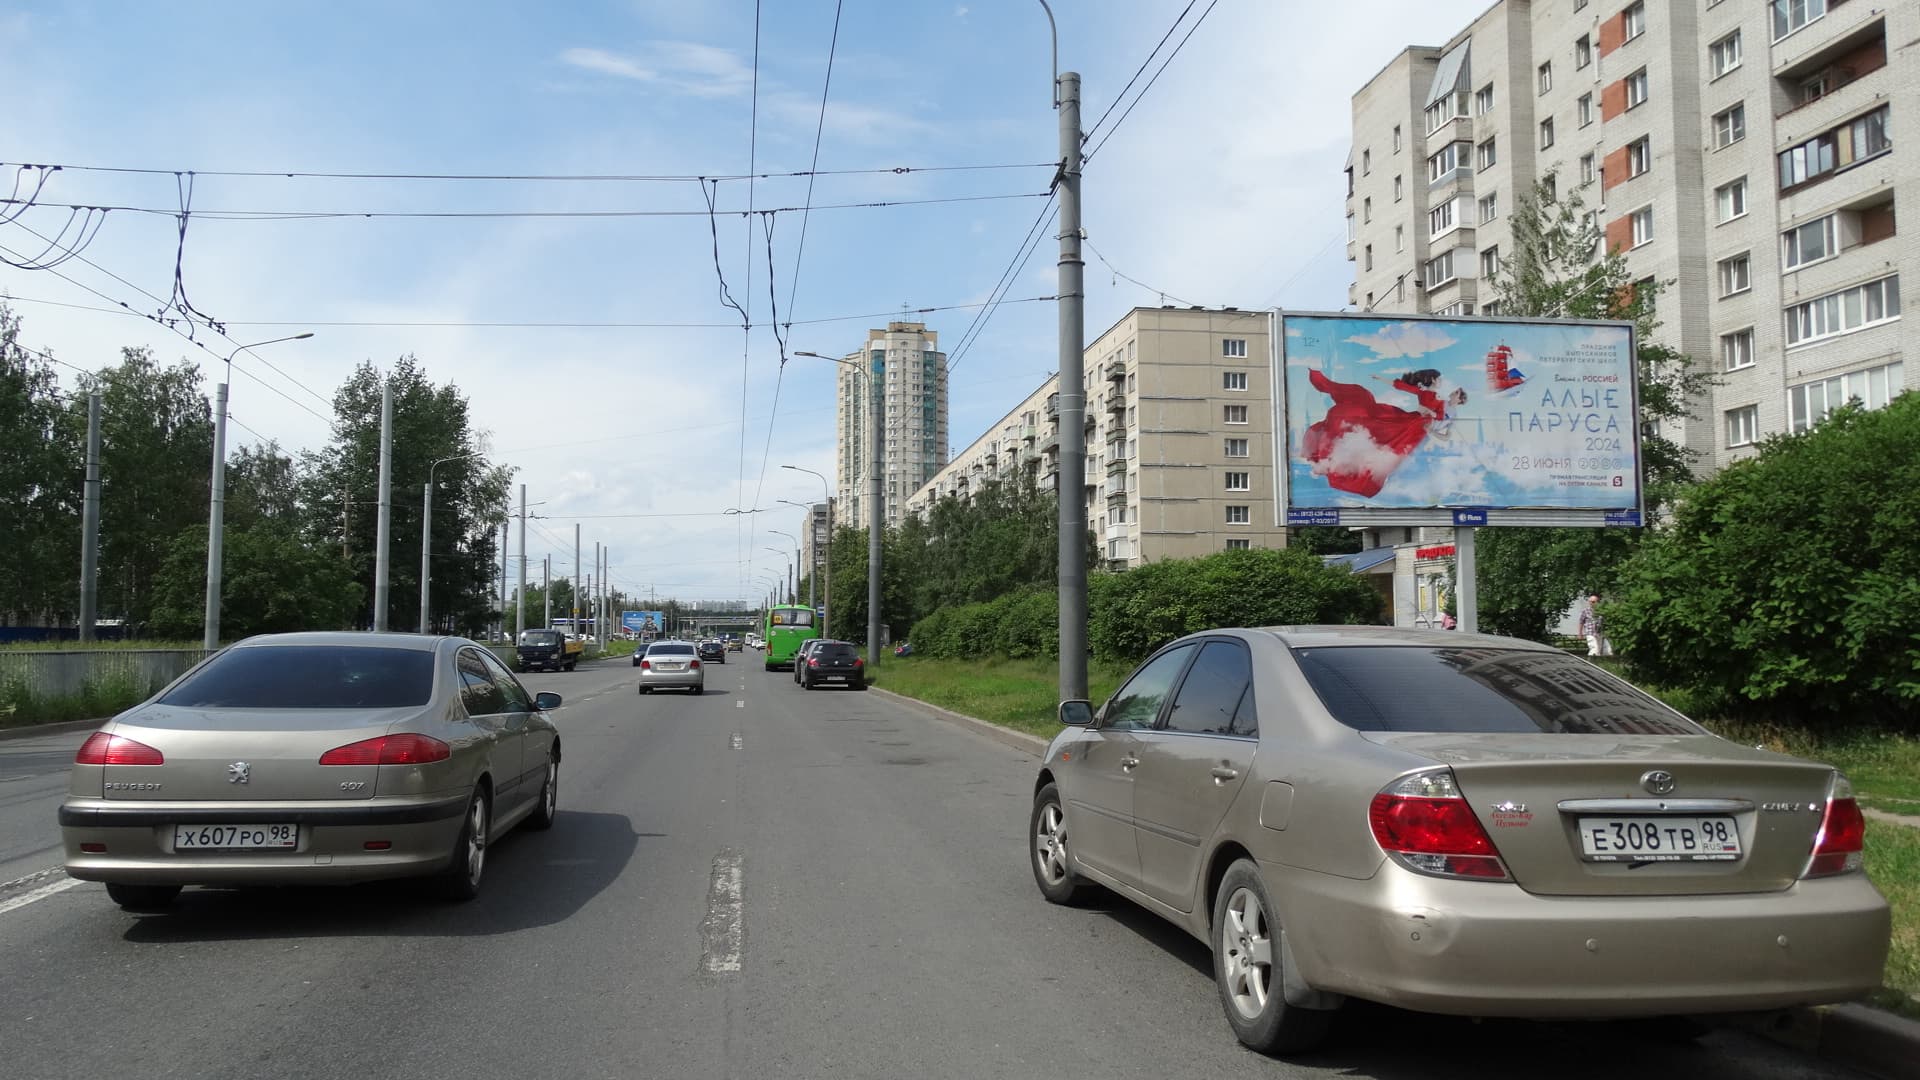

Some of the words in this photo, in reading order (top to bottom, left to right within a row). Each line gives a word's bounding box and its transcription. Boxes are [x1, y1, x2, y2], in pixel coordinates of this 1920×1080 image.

[1582, 374, 1619, 383] РОССИЕЙ
[1541, 387, 1619, 409] АЛЫЕ
[1508, 411, 1620, 434] ПАРУСА
[1585, 437, 1621, 451] 2024
[1511, 455, 1530, 470] 28
[1533, 457, 1572, 470] ИЮНЯ
[104, 782, 162, 791] PEUGEOT
[340, 781, 366, 791] 607
[184, 827, 265, 846] Х607РО
[270, 826, 290, 840] 98
[1592, 822, 1696, 850] Е308ТВ
[1702, 821, 1728, 842] 98
[1703, 843, 1722, 851] RUS
